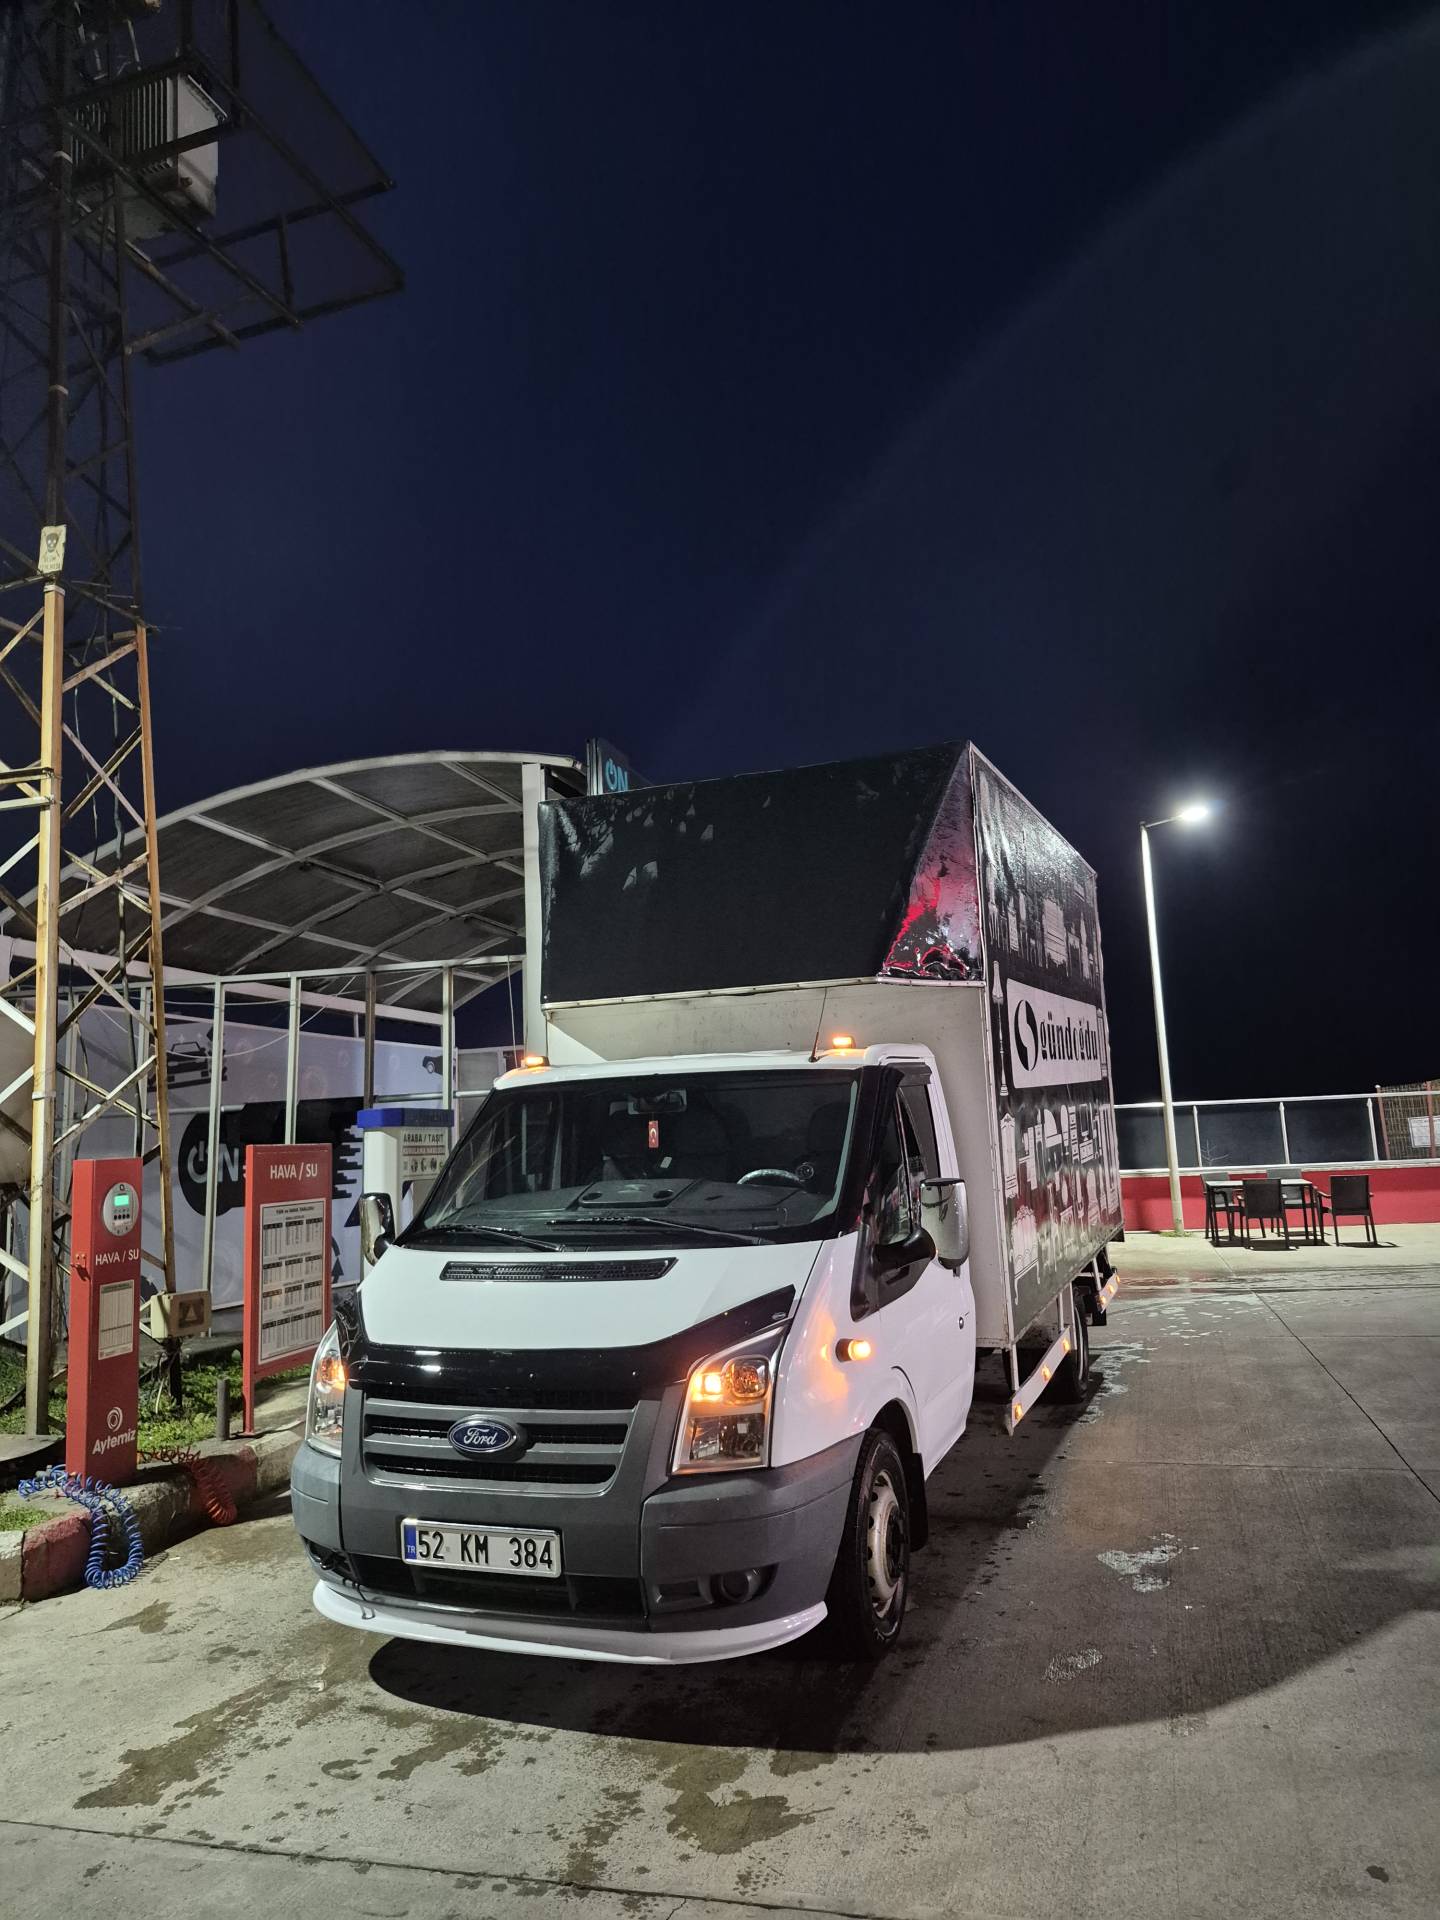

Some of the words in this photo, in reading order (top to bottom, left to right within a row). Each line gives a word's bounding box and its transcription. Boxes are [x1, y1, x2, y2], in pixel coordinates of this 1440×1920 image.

[403, 1133, 422, 1143] ARABA
[428, 1133, 444, 1145] TAŞIT
[270, 1164, 297, 1180] HAVA
[298, 1162, 305, 1181] /
[306, 1163, 318, 1178] SU
[95, 1251, 120, 1266] HAVA
[128, 1248, 140, 1261] SU
[92, 1428, 136, 1455] Aytemiz
[463, 1427, 498, 1446] Ford
[407, 1545, 416, 1554] TR
[418, 1530, 444, 1561] 52
[460, 1533, 489, 1565] KM
[509, 1537, 553, 1570] 384
